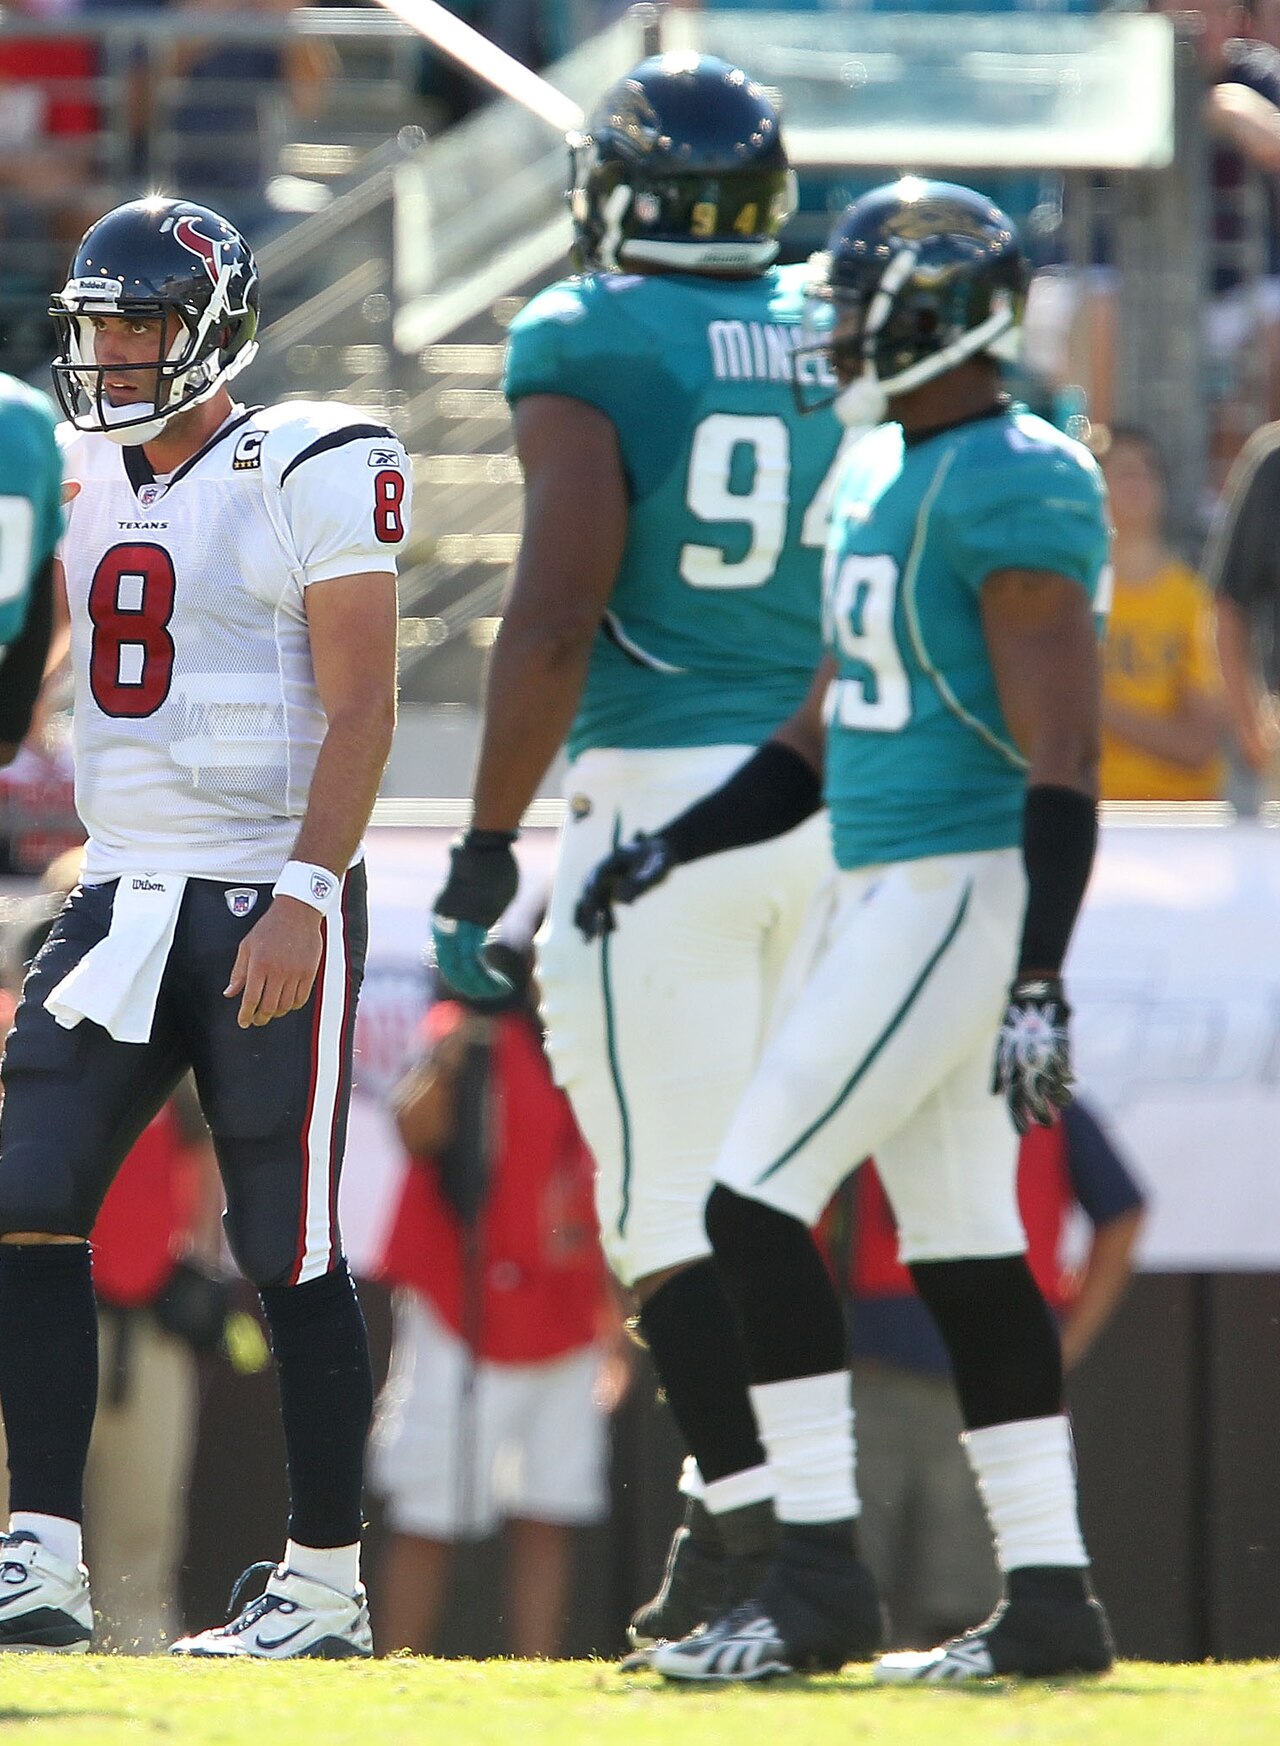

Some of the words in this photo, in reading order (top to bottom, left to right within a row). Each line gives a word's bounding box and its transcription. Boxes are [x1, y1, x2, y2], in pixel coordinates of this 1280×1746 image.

[117, 521, 169, 530] TEXANS
[374, 470, 405, 543] 8
[88, 541, 177, 719] 8
[822, 552, 914, 733] 9
[131, 878, 166, 892] Wilson
